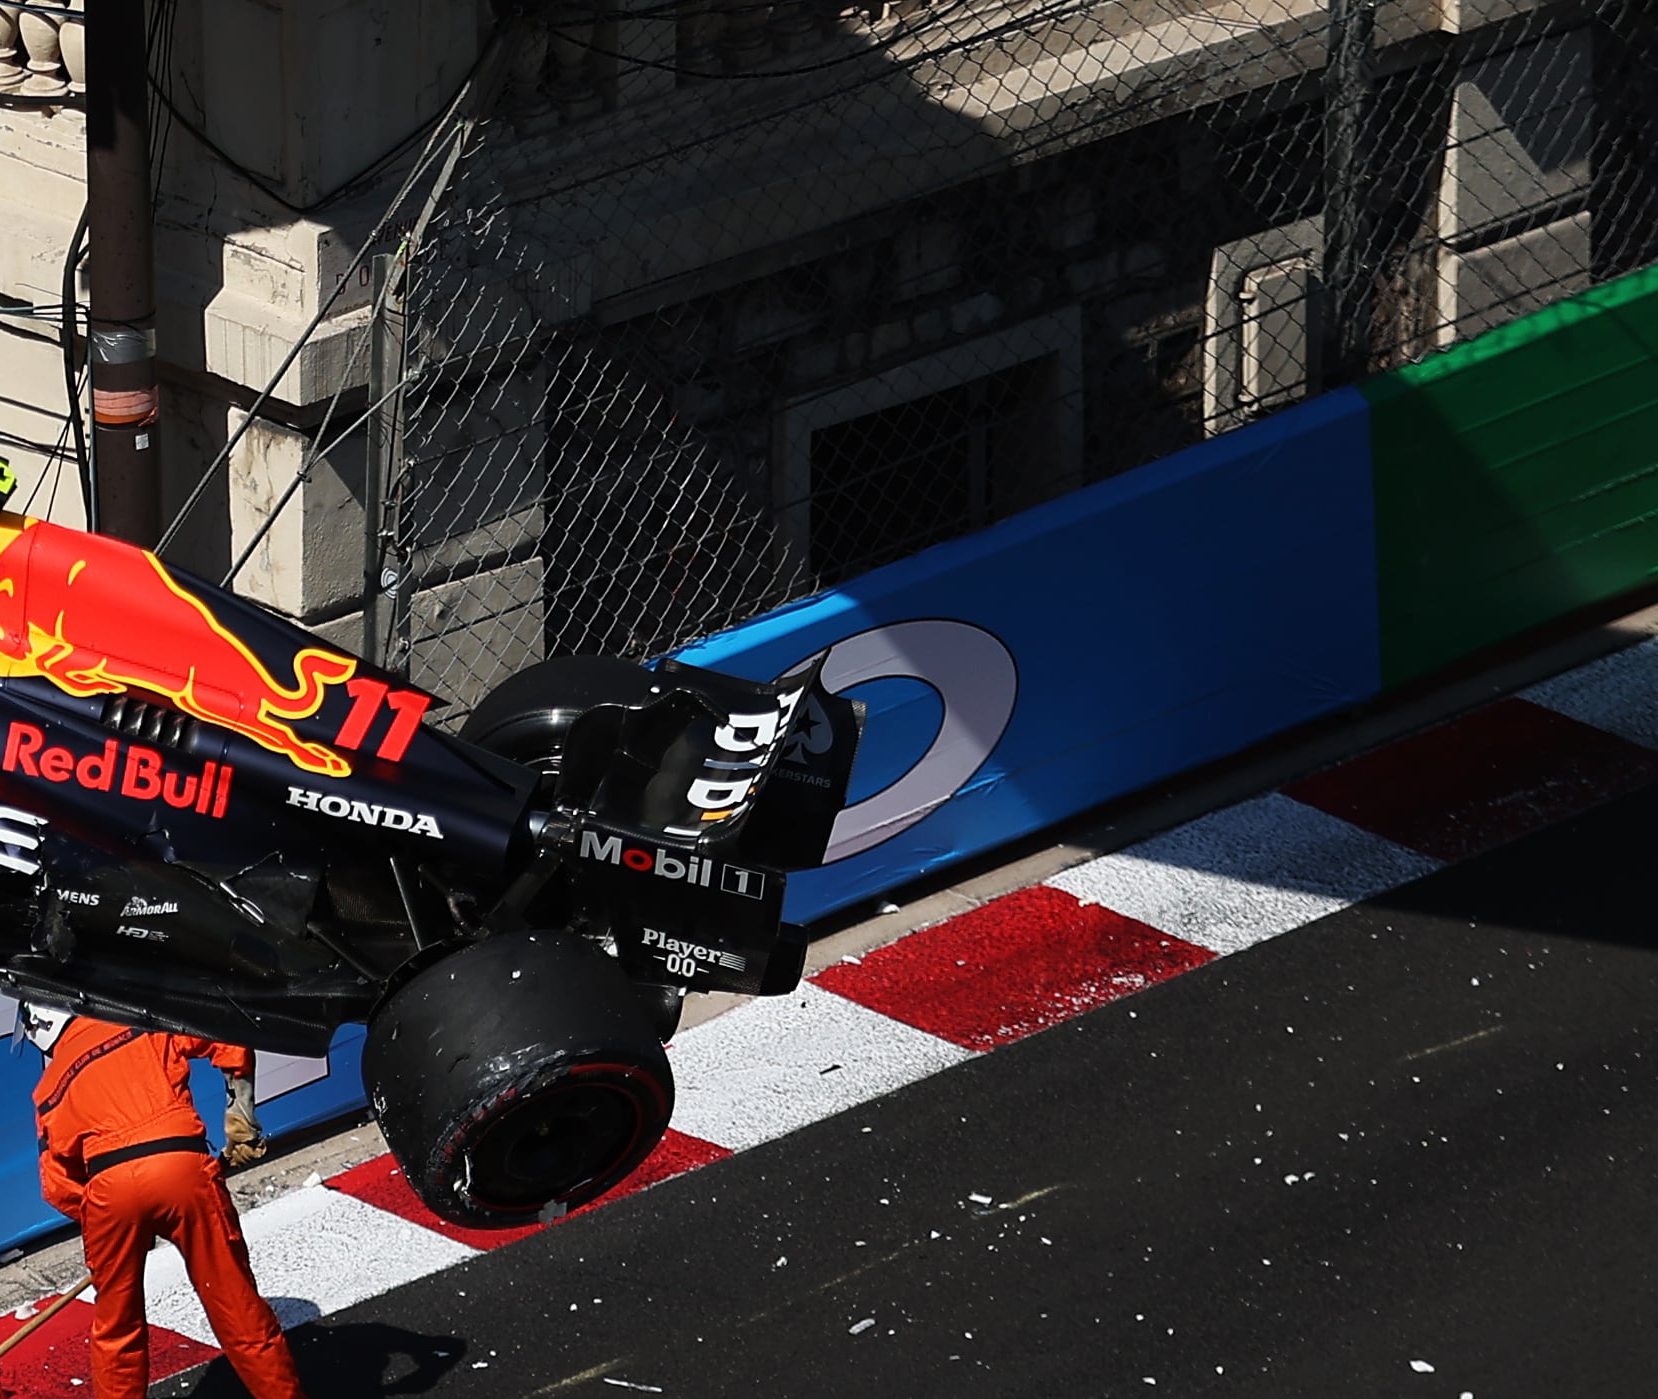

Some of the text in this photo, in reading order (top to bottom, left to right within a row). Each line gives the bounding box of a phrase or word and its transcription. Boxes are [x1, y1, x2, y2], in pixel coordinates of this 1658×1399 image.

[334, 677, 432, 763] 11
[2, 721, 234, 819] Red Bull
[771, 767, 832, 789] KERSTARS
[286, 785, 444, 839] HONDA
[580, 830, 713, 887] Mobil
[642, 927, 723, 965] Player
